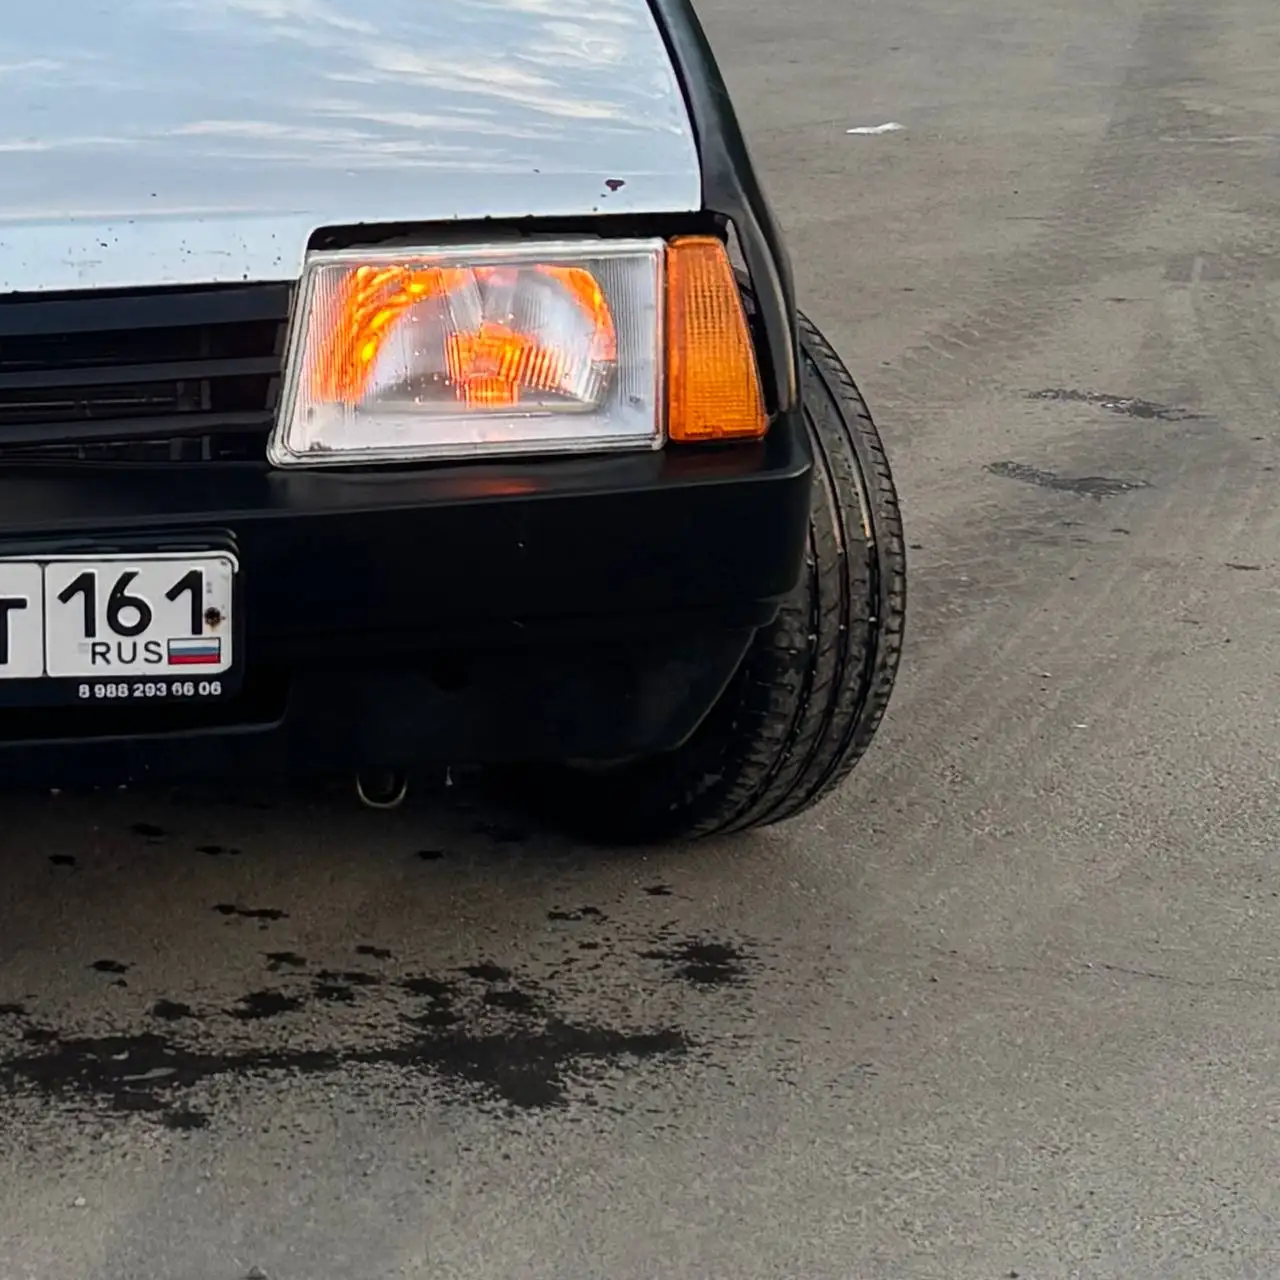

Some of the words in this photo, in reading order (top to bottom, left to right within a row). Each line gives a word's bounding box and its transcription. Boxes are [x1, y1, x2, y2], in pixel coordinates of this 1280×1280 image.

[57, 571, 205, 638] 161
[91, 639, 164, 665] RUS
[78, 683, 90, 699] 8
[132, 682, 167, 698] 293
[171, 681, 195, 696] 66
[198, 680, 222, 696] 06
